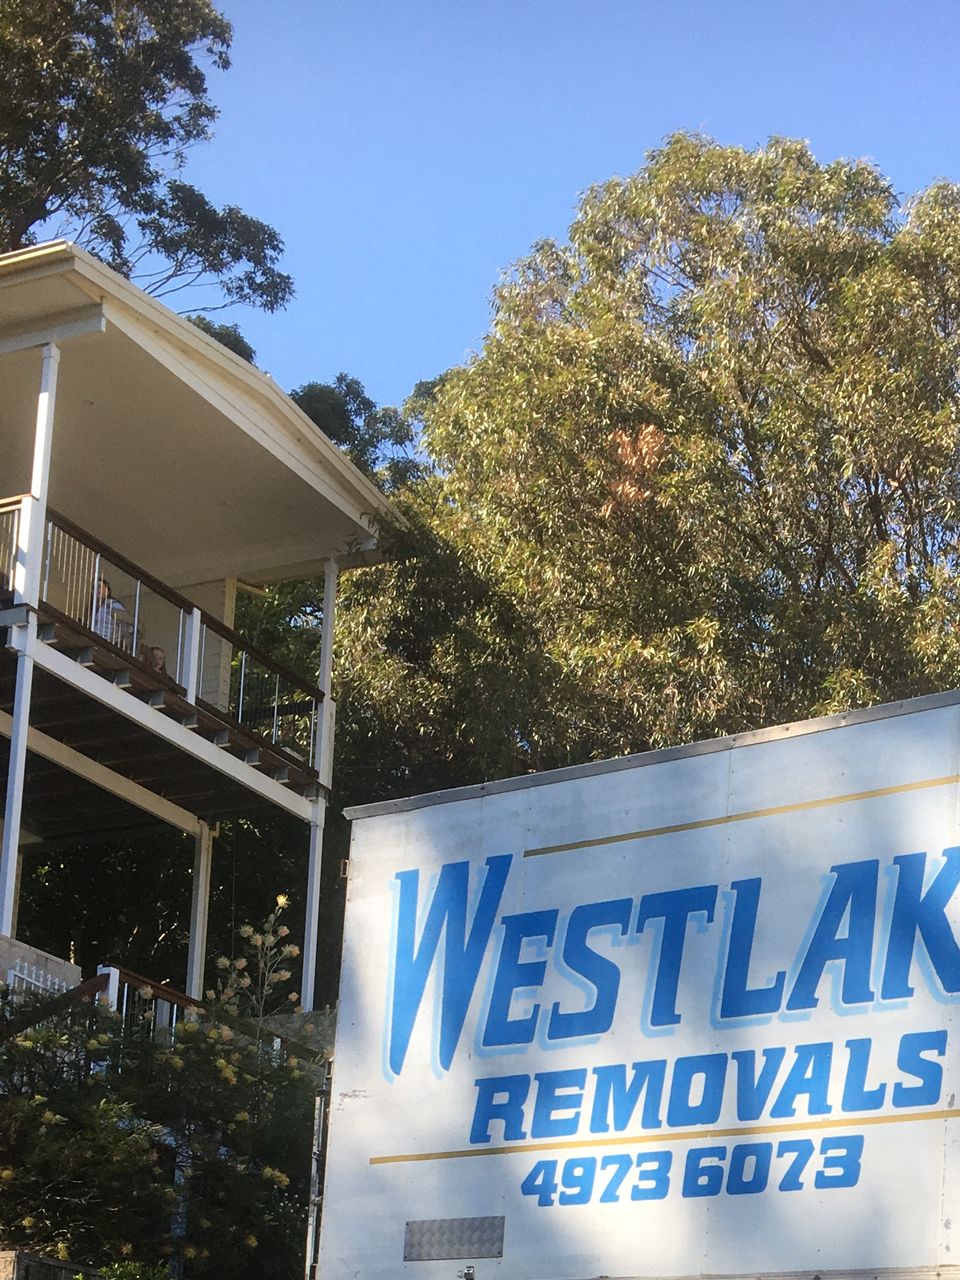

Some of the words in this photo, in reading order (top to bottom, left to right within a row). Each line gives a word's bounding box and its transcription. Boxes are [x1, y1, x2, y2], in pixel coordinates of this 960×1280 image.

[469, 1030, 948, 1144] REMOVALS
[520, 1147, 673, 1206] 4973
[682, 1135, 864, 1198] 6073
